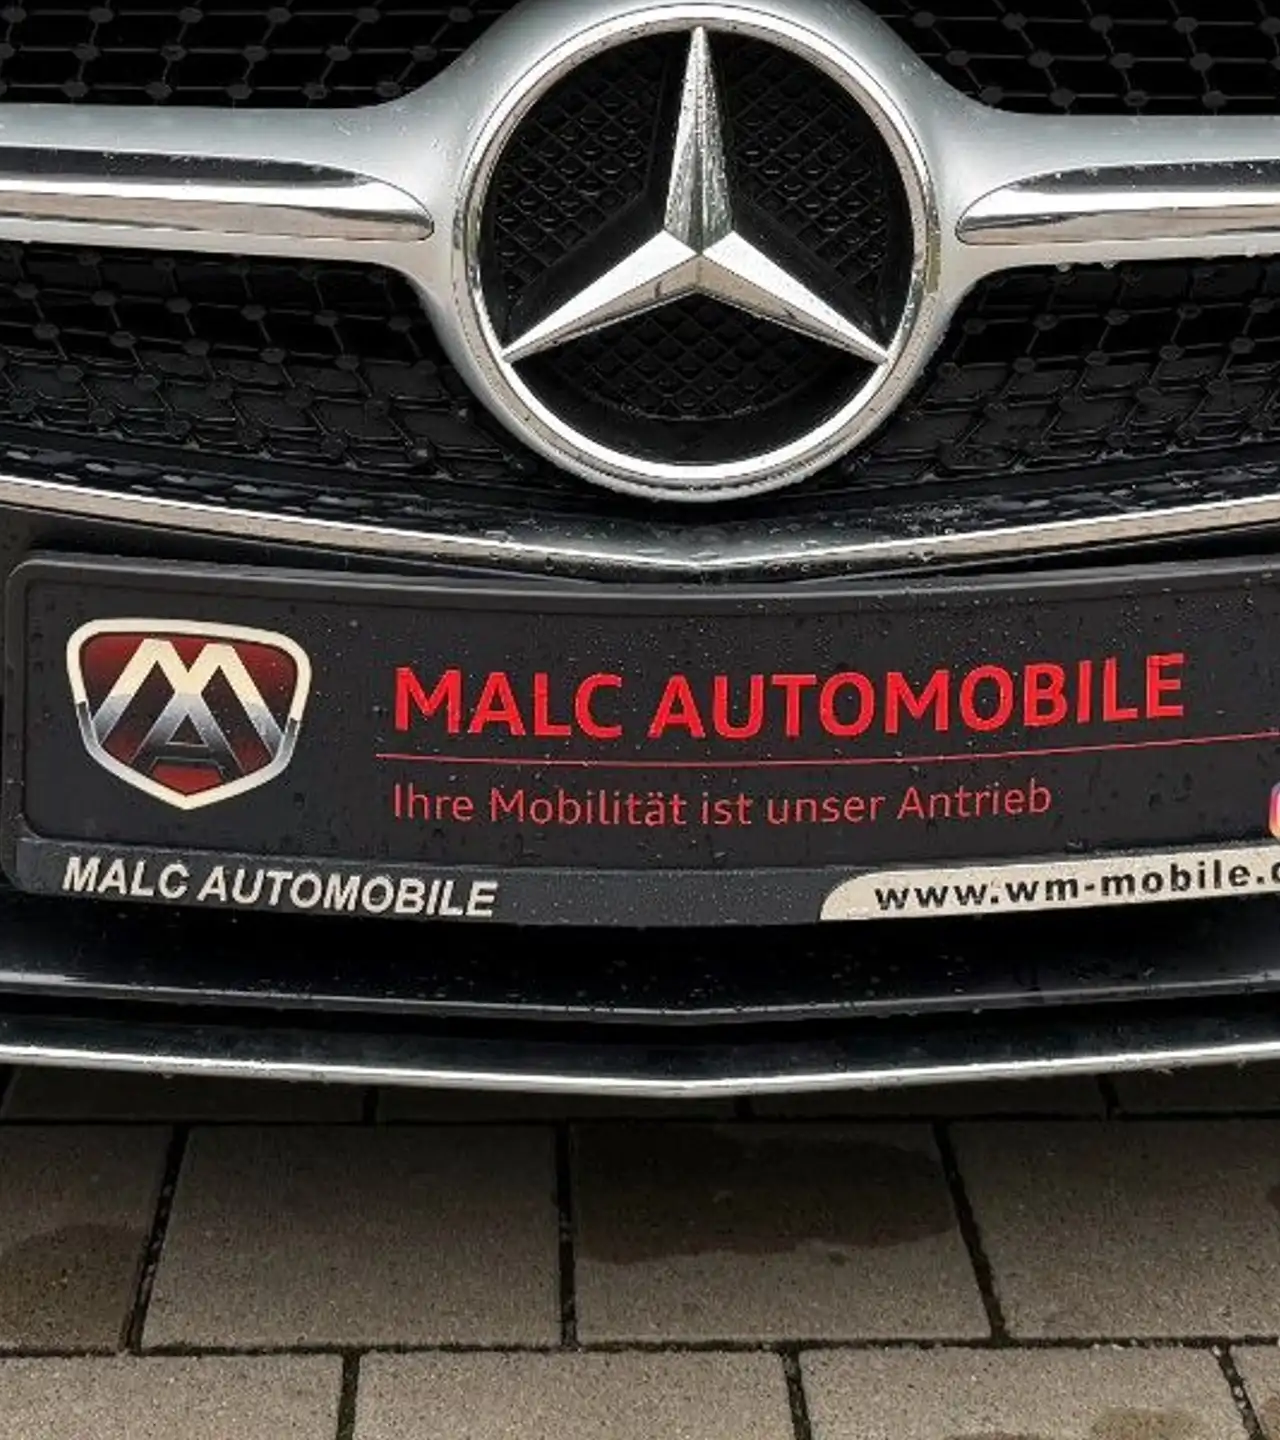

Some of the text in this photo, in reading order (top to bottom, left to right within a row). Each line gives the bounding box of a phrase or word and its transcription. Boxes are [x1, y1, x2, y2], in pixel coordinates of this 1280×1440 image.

[393, 652, 1185, 740] MALC AUTOMOBILE
[392, 777, 1053, 827] Ihre Mobilität ist unser Antrieb
[62, 856, 500, 918] MALC AUTOMOBILE
